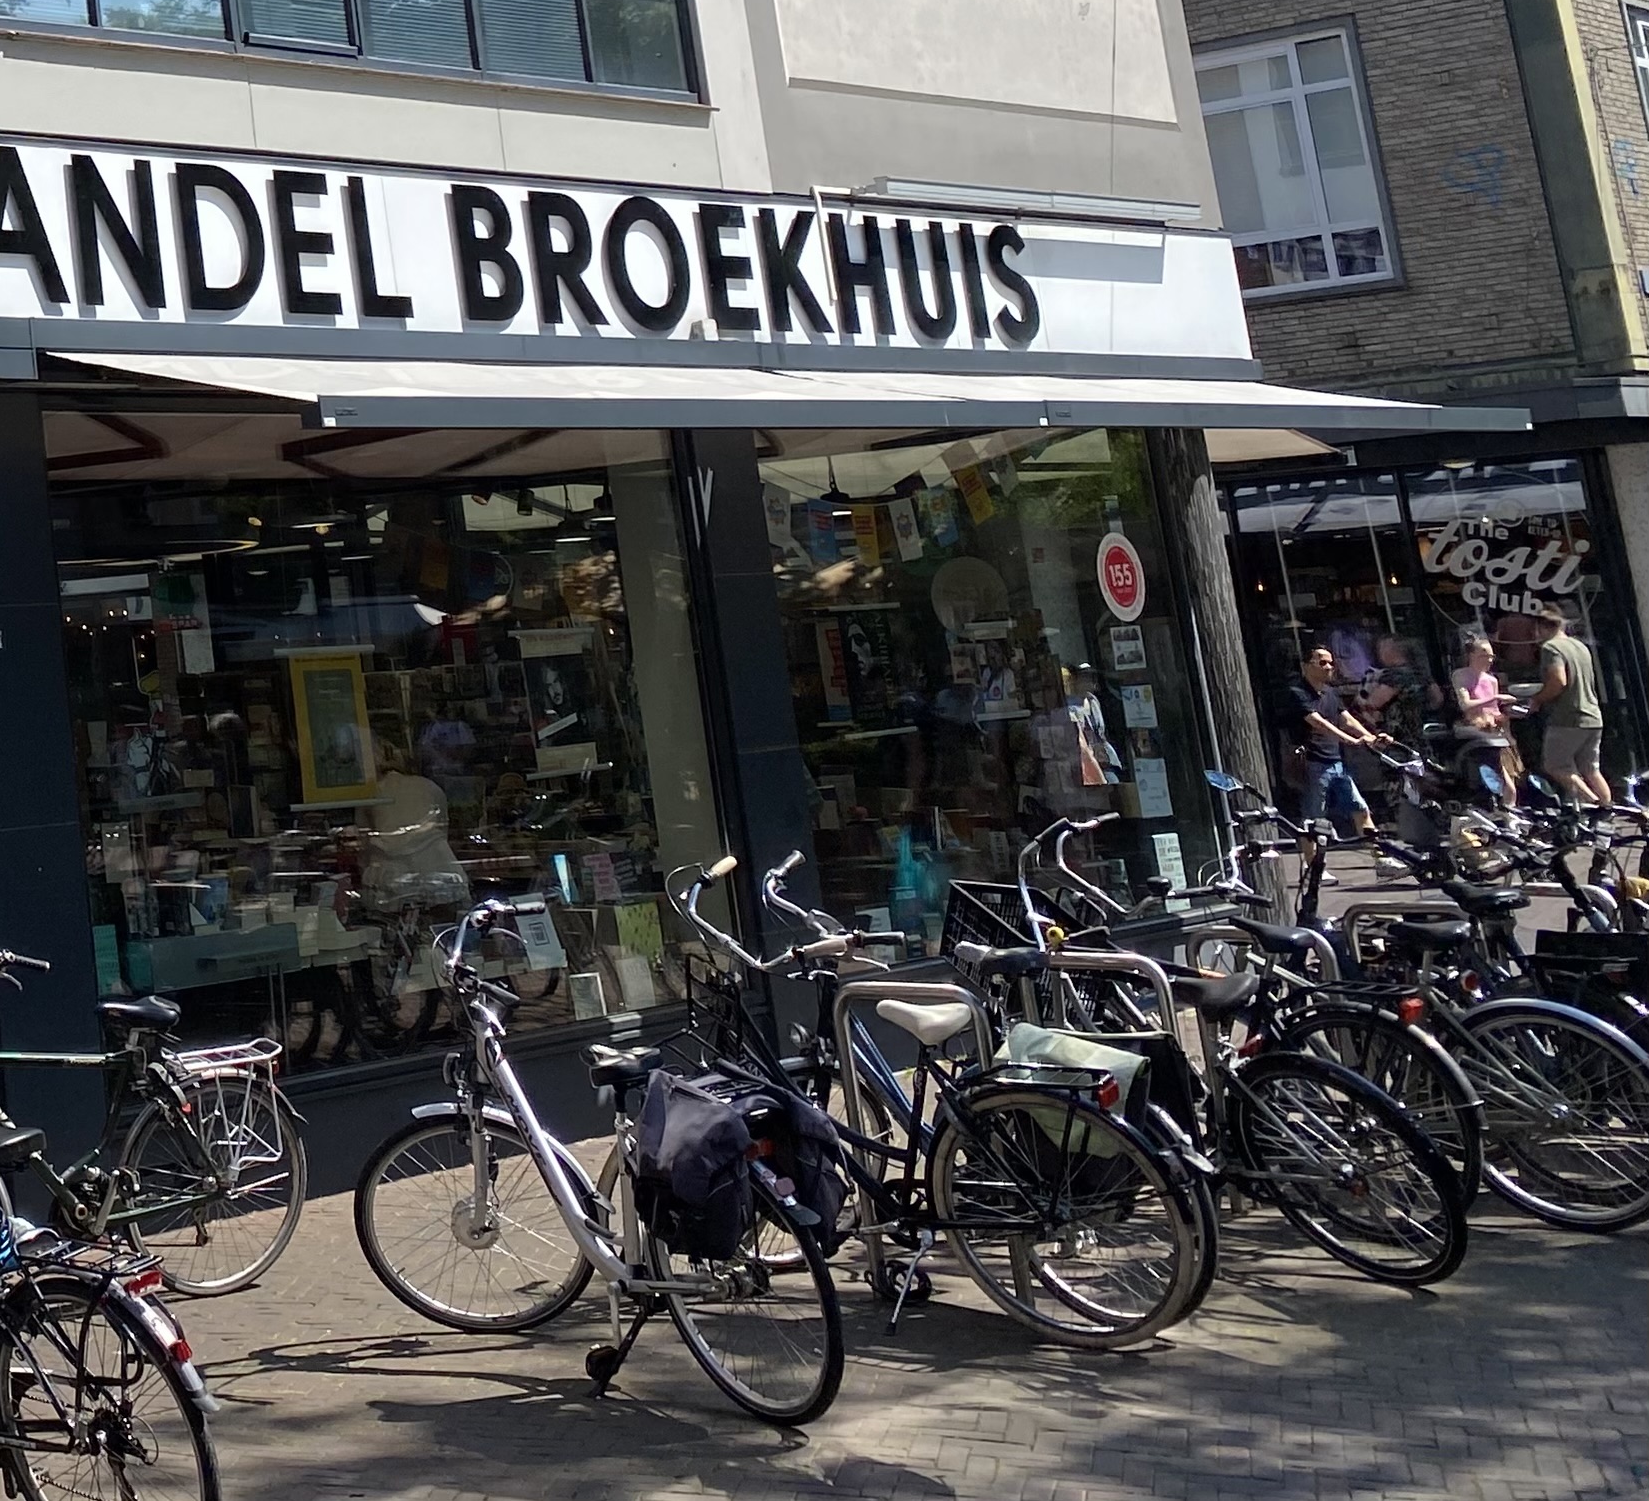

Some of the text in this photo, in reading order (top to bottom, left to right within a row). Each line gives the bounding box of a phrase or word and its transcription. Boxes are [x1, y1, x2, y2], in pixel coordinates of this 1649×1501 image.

[452, 183, 1041, 344] BROEKHUIS
[1109, 563, 1132, 587] 155
[1424, 519, 1590, 594] tosti
[1462, 581, 1544, 615] Club
